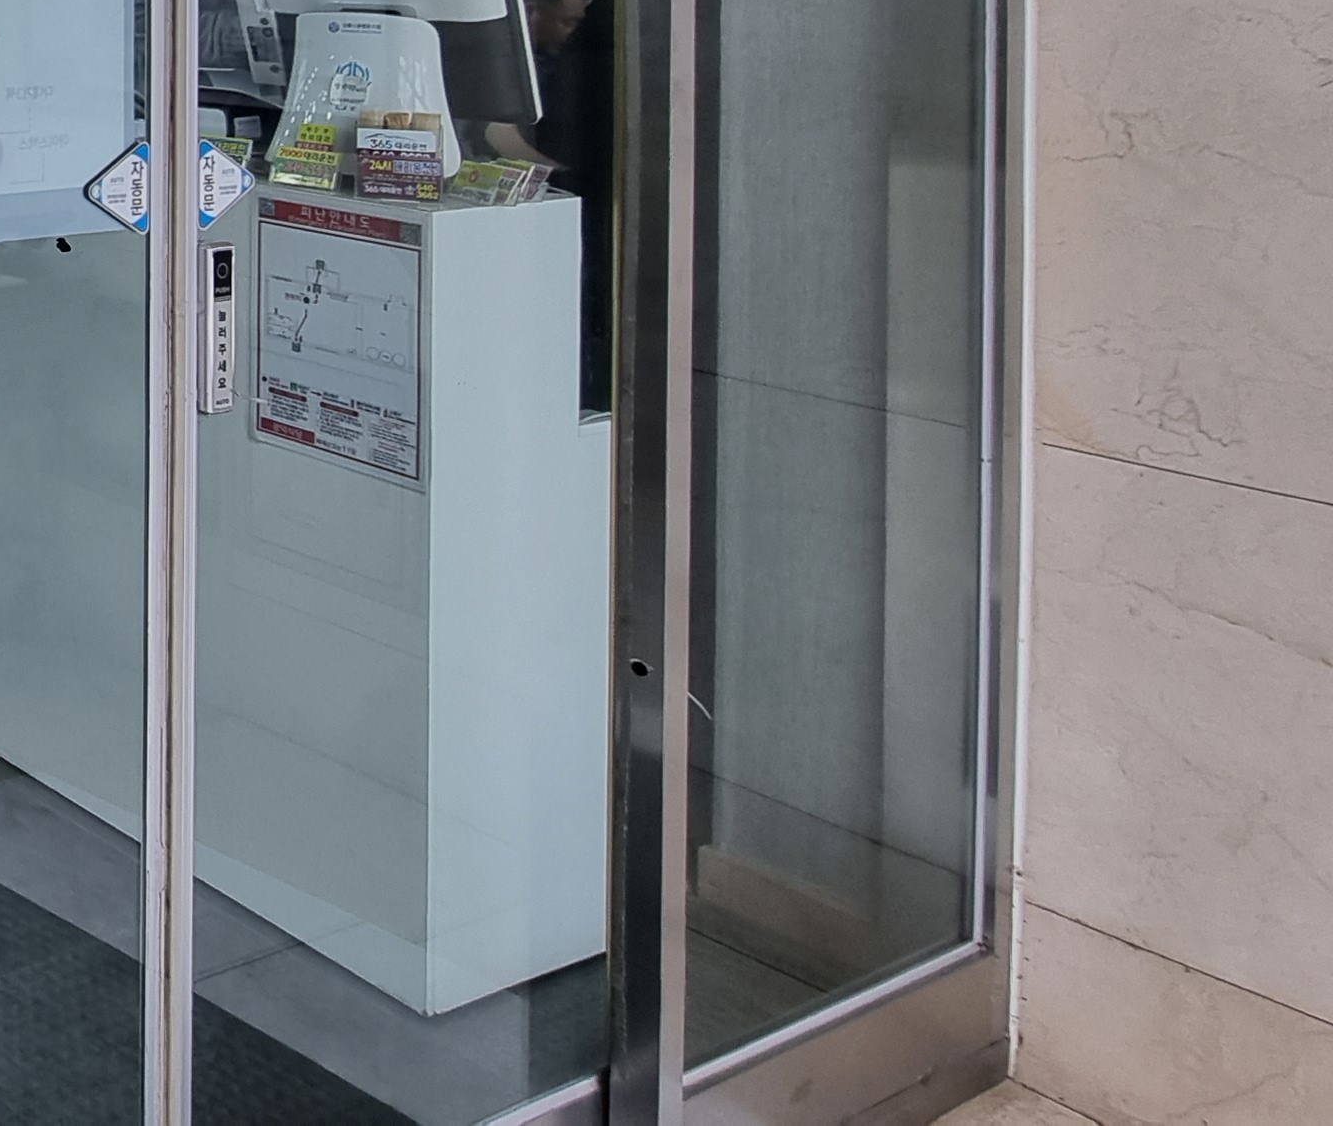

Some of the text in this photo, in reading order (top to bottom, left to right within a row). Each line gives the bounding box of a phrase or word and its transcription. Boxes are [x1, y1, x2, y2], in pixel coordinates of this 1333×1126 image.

[130, 160, 145, 217] 자동문
[202, 154, 216, 212] 자동문
[301, 205, 371, 229] 피난안내도
[217, 309, 227, 389] 눌러주세요
